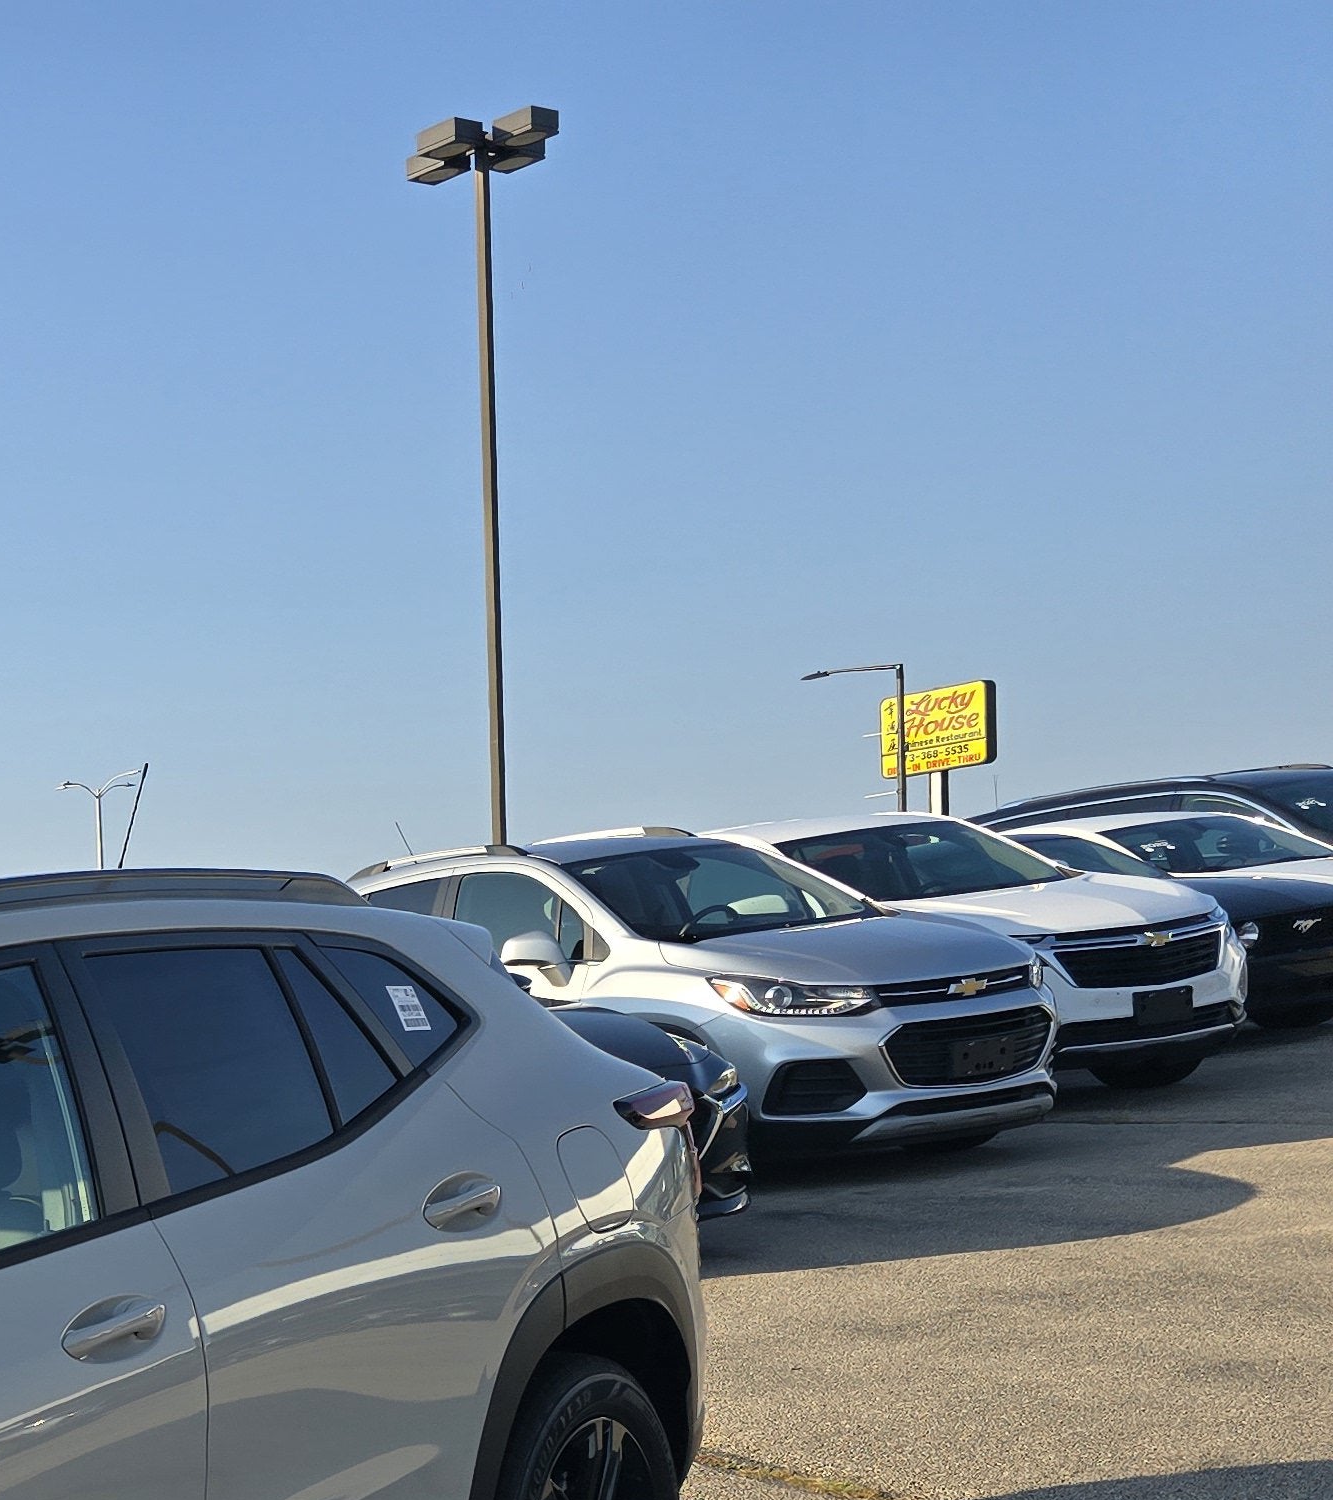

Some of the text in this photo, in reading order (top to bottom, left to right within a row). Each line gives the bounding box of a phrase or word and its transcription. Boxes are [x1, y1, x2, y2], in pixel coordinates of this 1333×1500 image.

[905, 690, 976, 716] Lucky
[904, 712, 979, 738] House
[935, 729, 982, 743] Restaurant
[926, 753, 981, 769] DRIVE-THRU
